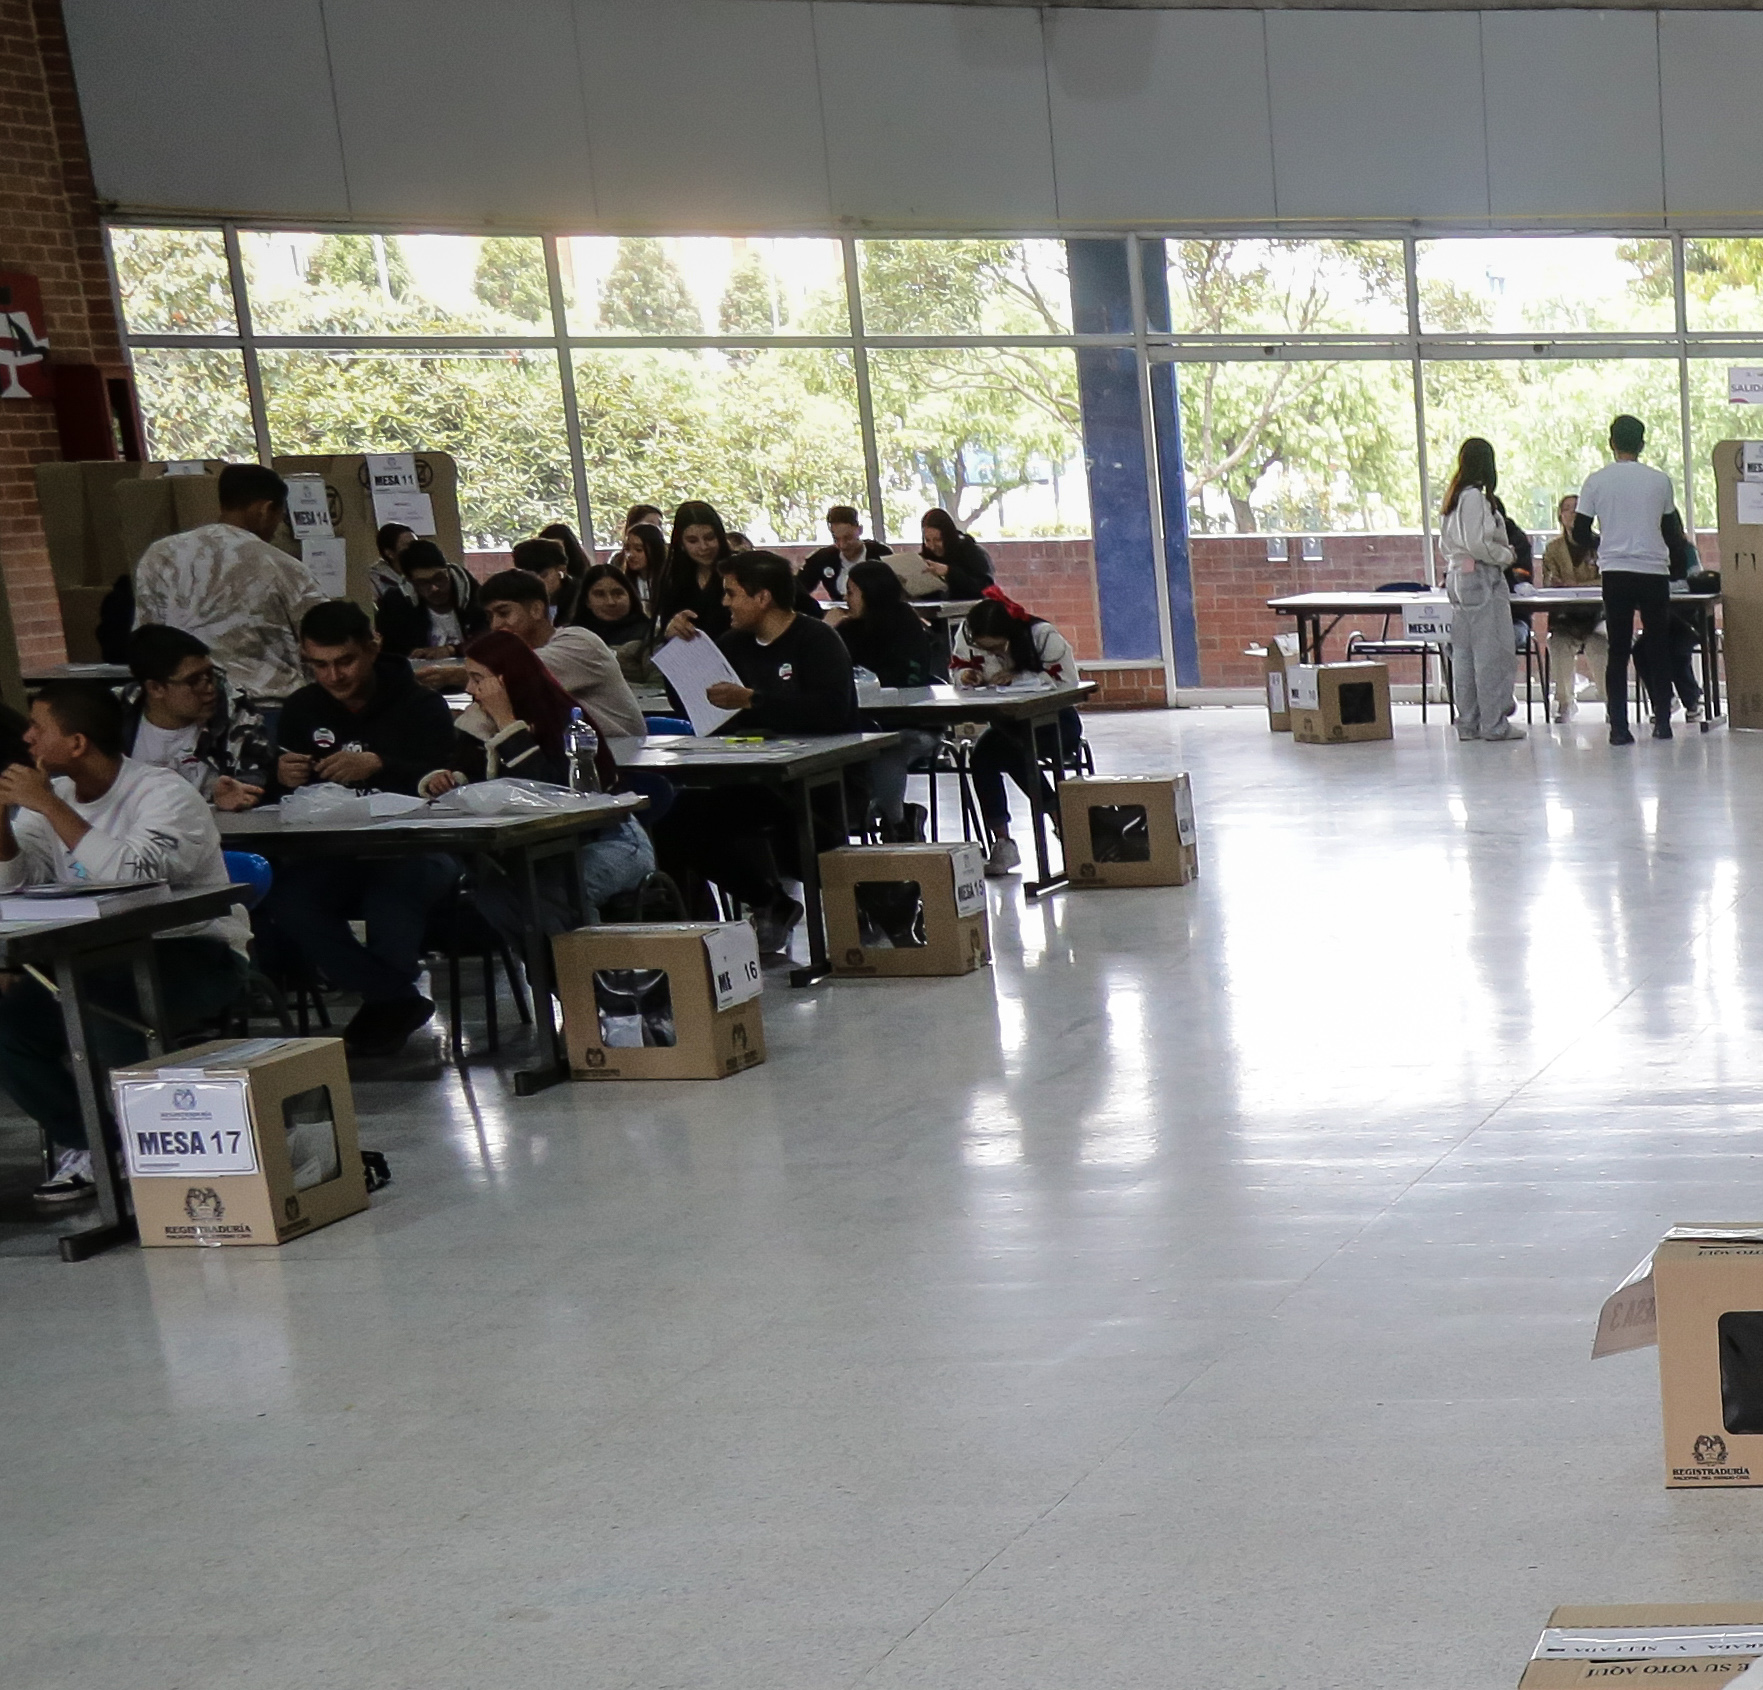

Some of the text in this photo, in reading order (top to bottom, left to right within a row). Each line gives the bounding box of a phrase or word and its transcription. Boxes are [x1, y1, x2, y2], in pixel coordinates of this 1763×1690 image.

[374, 474, 414, 487] MESA 11
[292, 511, 330, 527] MESA 14
[1408, 622, 1437, 634] MESA
[744, 961, 759, 983] 16
[137, 1130, 243, 1156] MESA 17
[1672, 1466, 1750, 1476] REGISTRADURÍA
[1642, 1664, 1699, 1676] VOTO
[1703, 1663, 1733, 1674] SU
